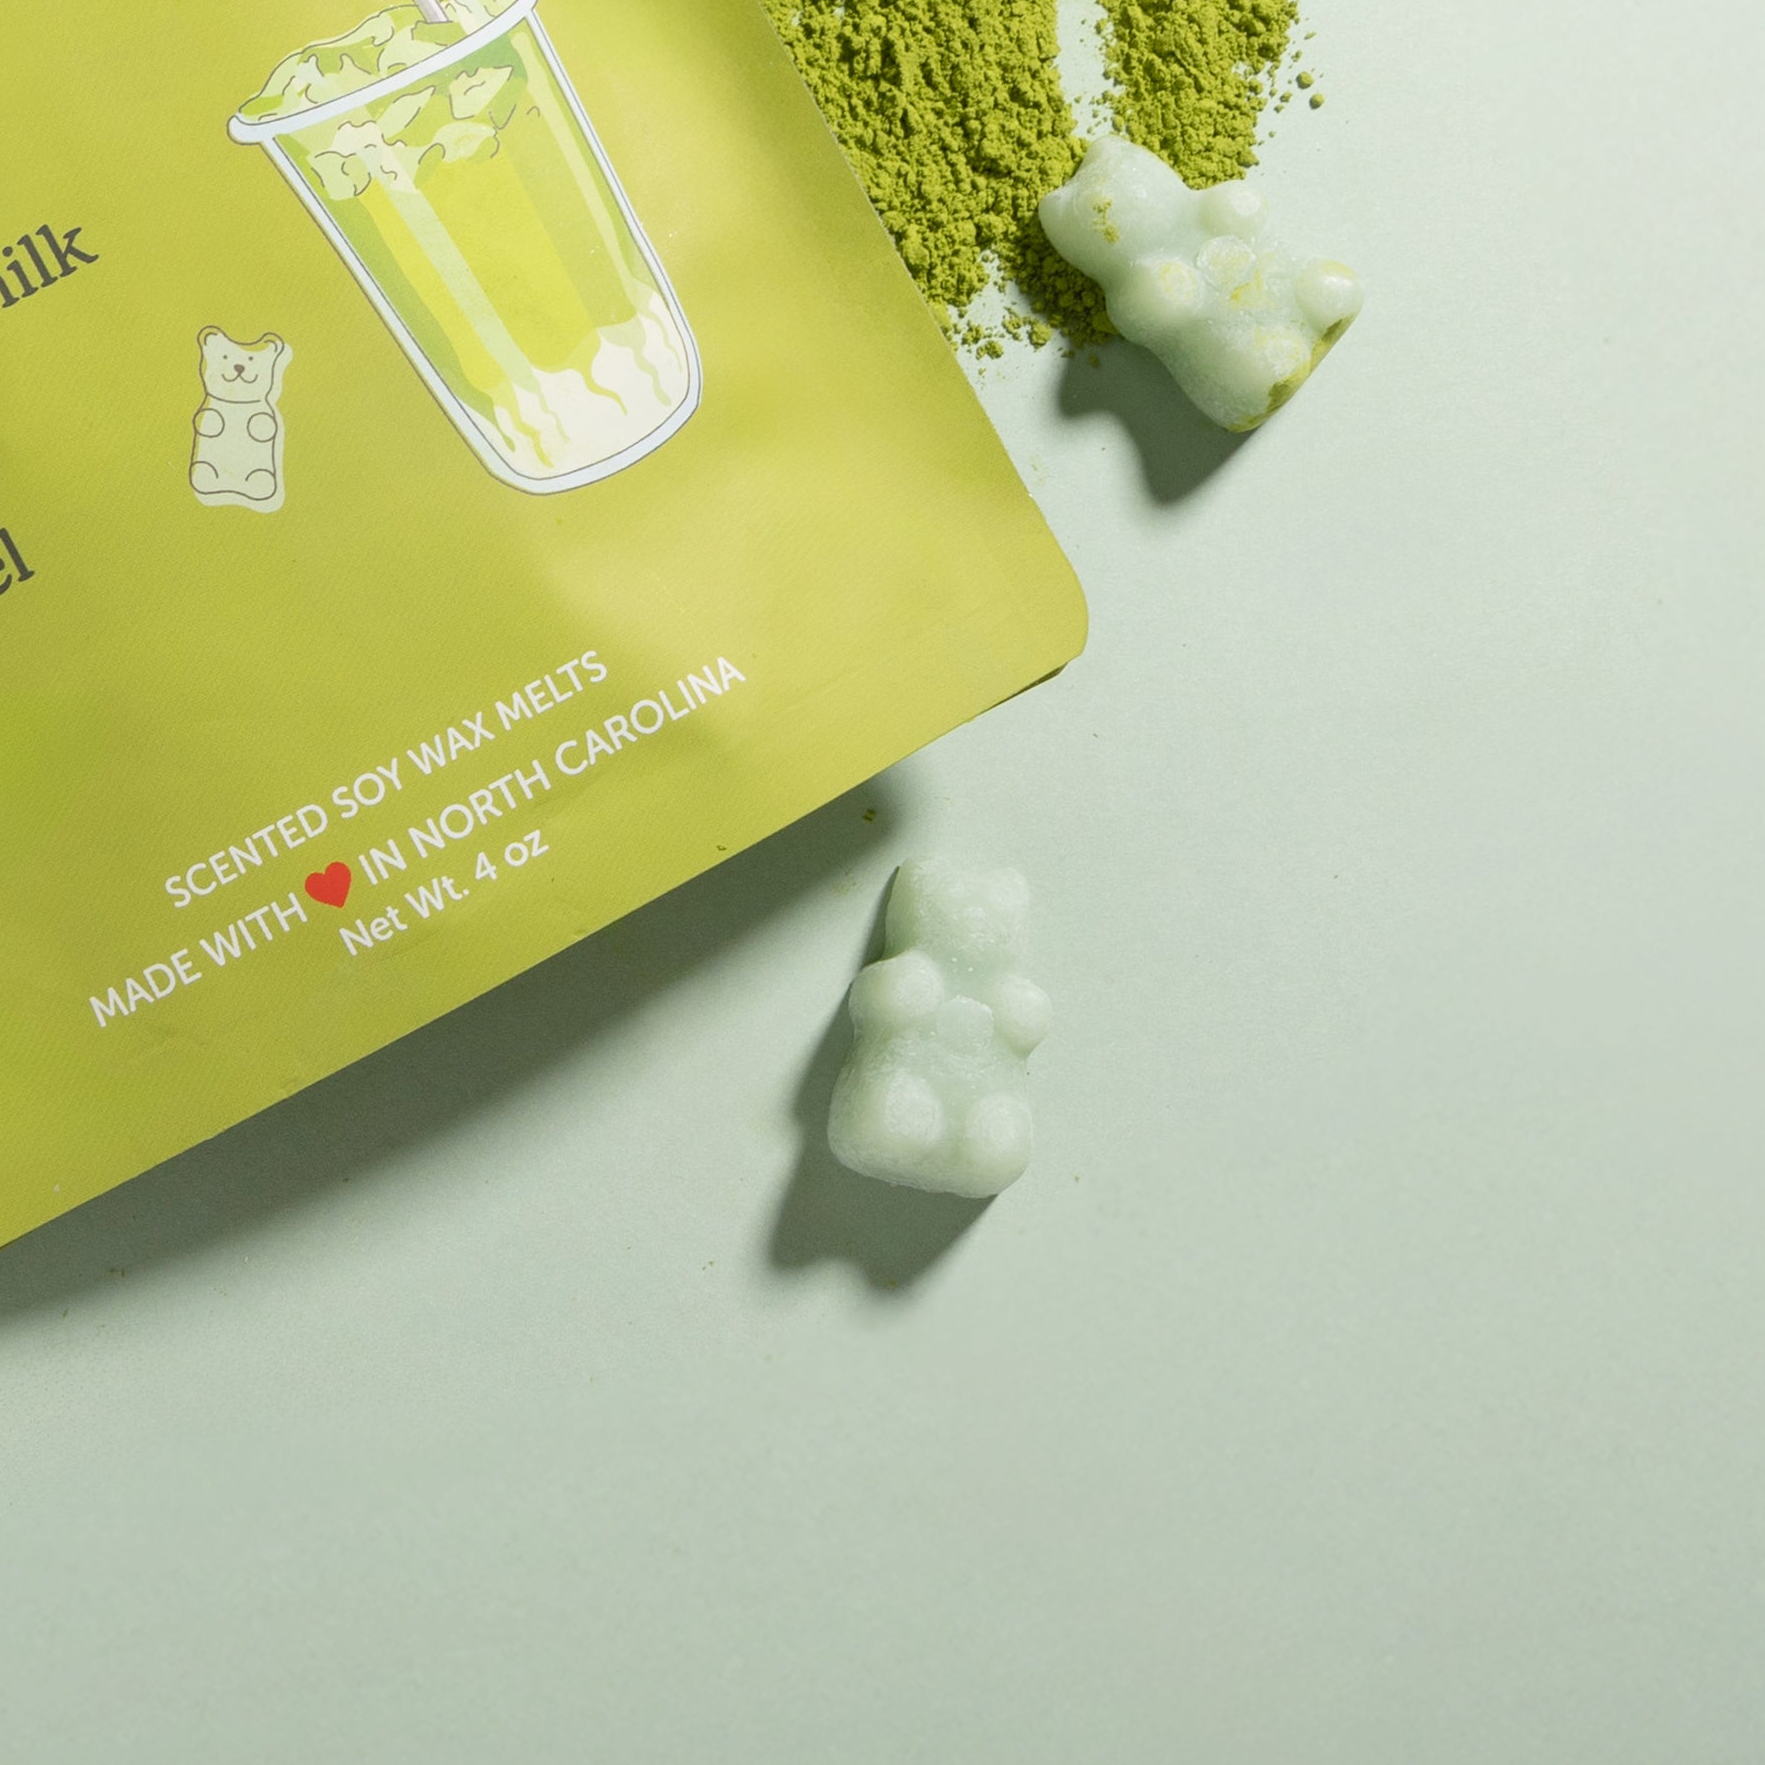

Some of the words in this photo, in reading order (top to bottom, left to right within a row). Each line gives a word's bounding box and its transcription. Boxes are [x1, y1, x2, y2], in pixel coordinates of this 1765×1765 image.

[89, 948, 202, 1028] MADE
[199, 892, 308, 967] WITH
[358, 839, 407, 885] IN
[408, 760, 551, 858] NORTH
[555, 656, 747, 775] CAROLINA
[165, 804, 328, 908] SCENTED
[332, 758, 402, 819] SOY
[406, 711, 495, 775] WAX
[495, 650, 607, 731] MELTS
[339, 906, 408, 956] Net
[404, 875, 469, 919] Wt.
[475, 852, 497, 880] 4
[504, 829, 550, 867] oz
